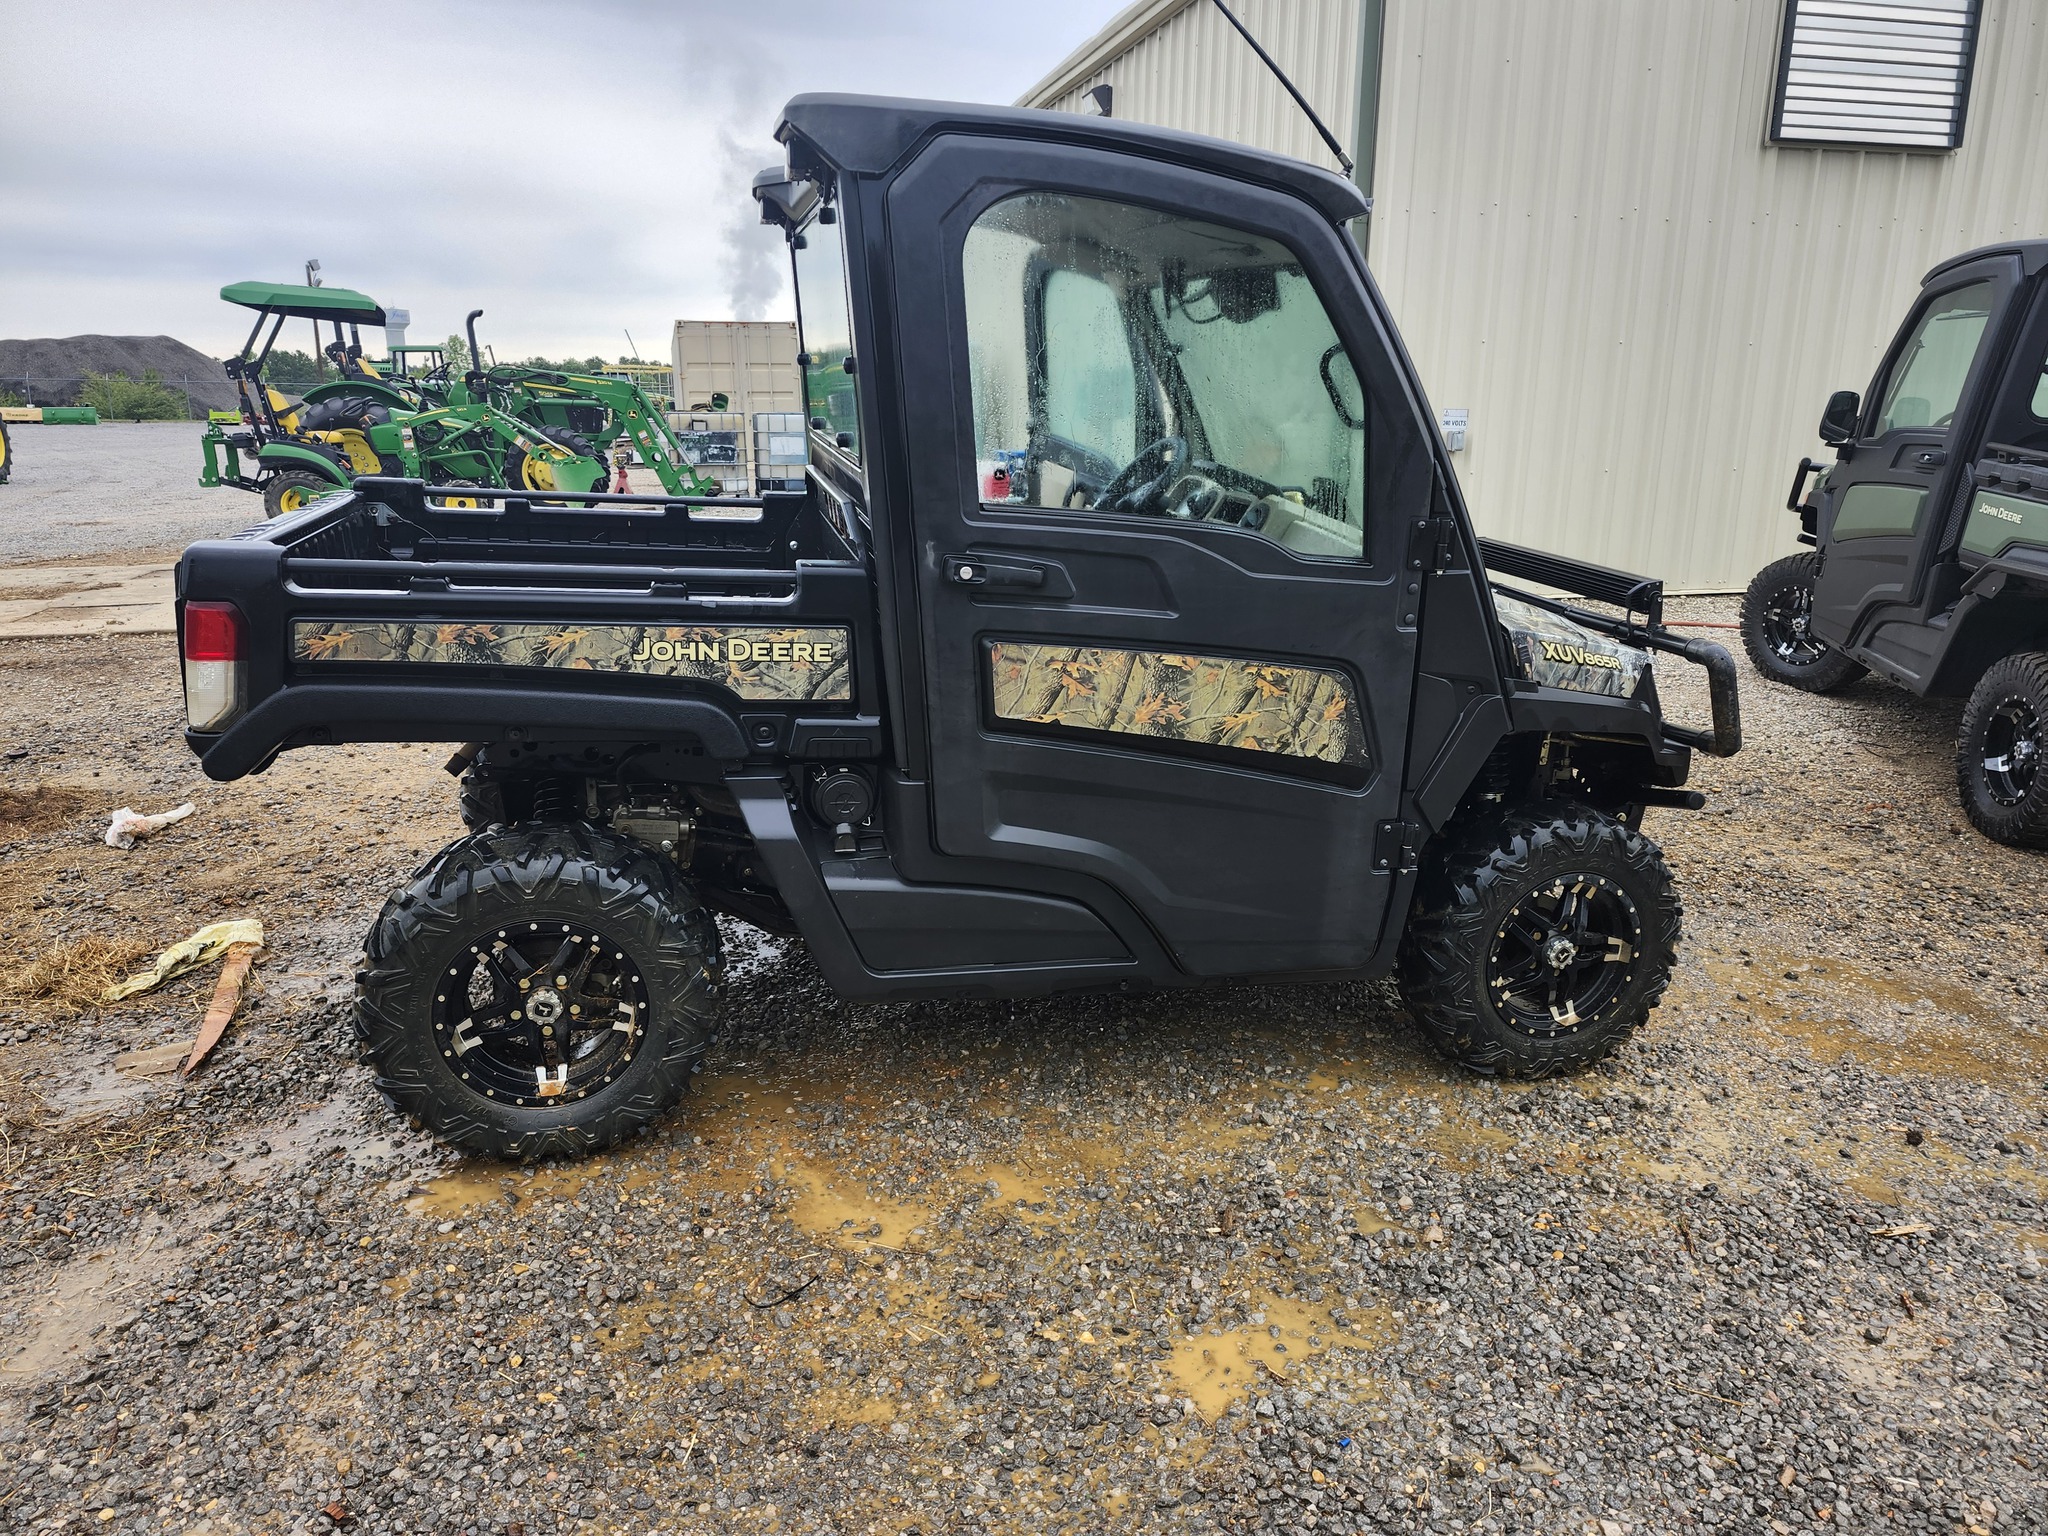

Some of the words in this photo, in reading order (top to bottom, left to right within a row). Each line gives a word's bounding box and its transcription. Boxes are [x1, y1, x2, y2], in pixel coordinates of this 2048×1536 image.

[1979, 502, 1999, 517] JOHN
[1998, 507, 2023, 524] DEERE
[632, 637, 721, 662] JOHN
[726, 637, 833, 663] DEERE
[1540, 640, 1622, 670] XUV865R
